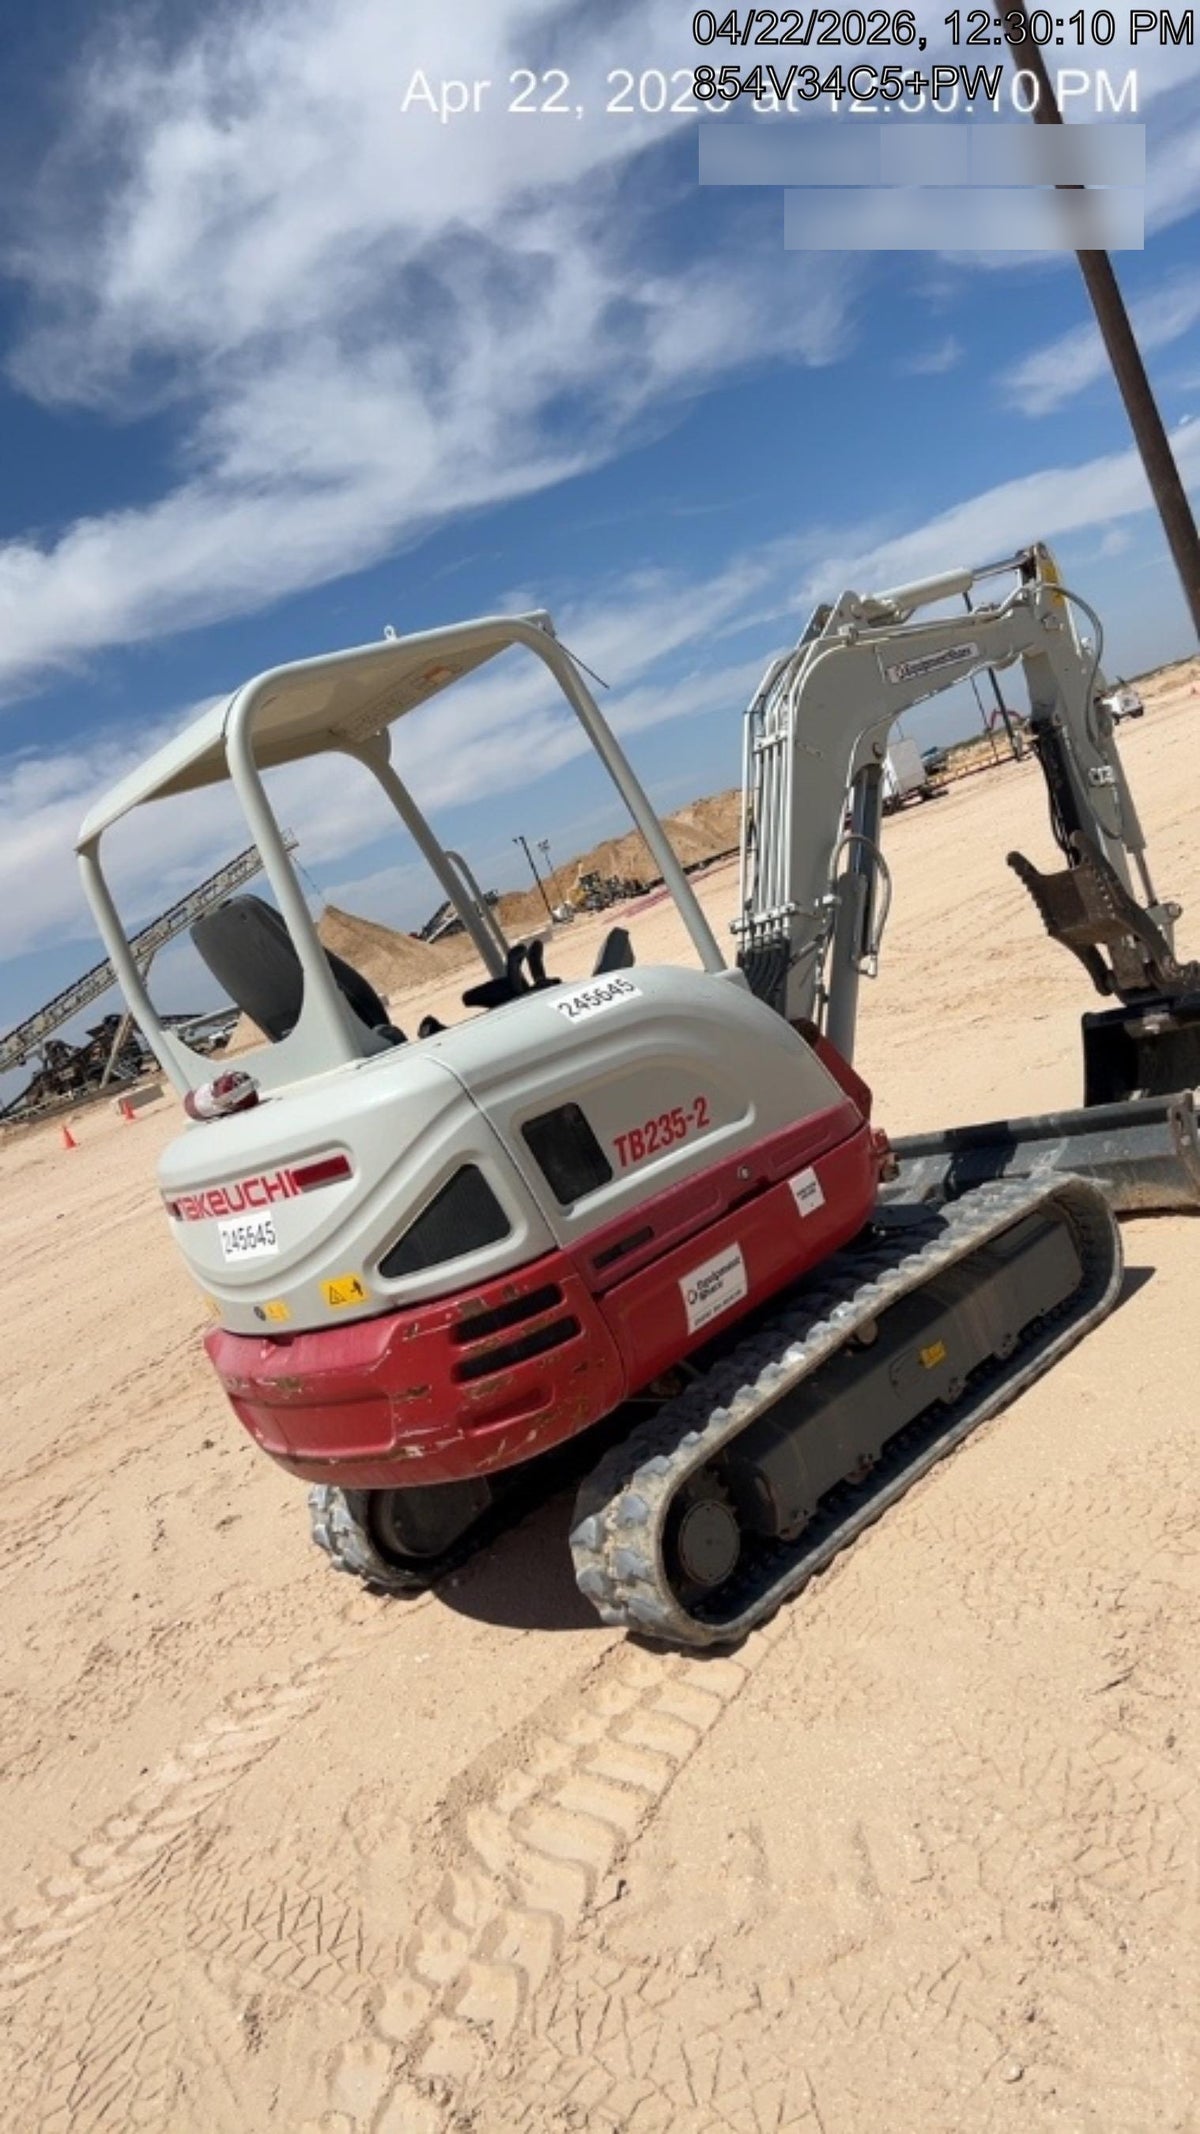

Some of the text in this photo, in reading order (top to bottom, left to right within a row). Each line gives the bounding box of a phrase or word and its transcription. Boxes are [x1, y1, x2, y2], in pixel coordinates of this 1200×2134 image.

[557, 978, 635, 1018] 245645
[613, 1096, 710, 1168] TB235-2
[221, 1220, 277, 1254] 245645
